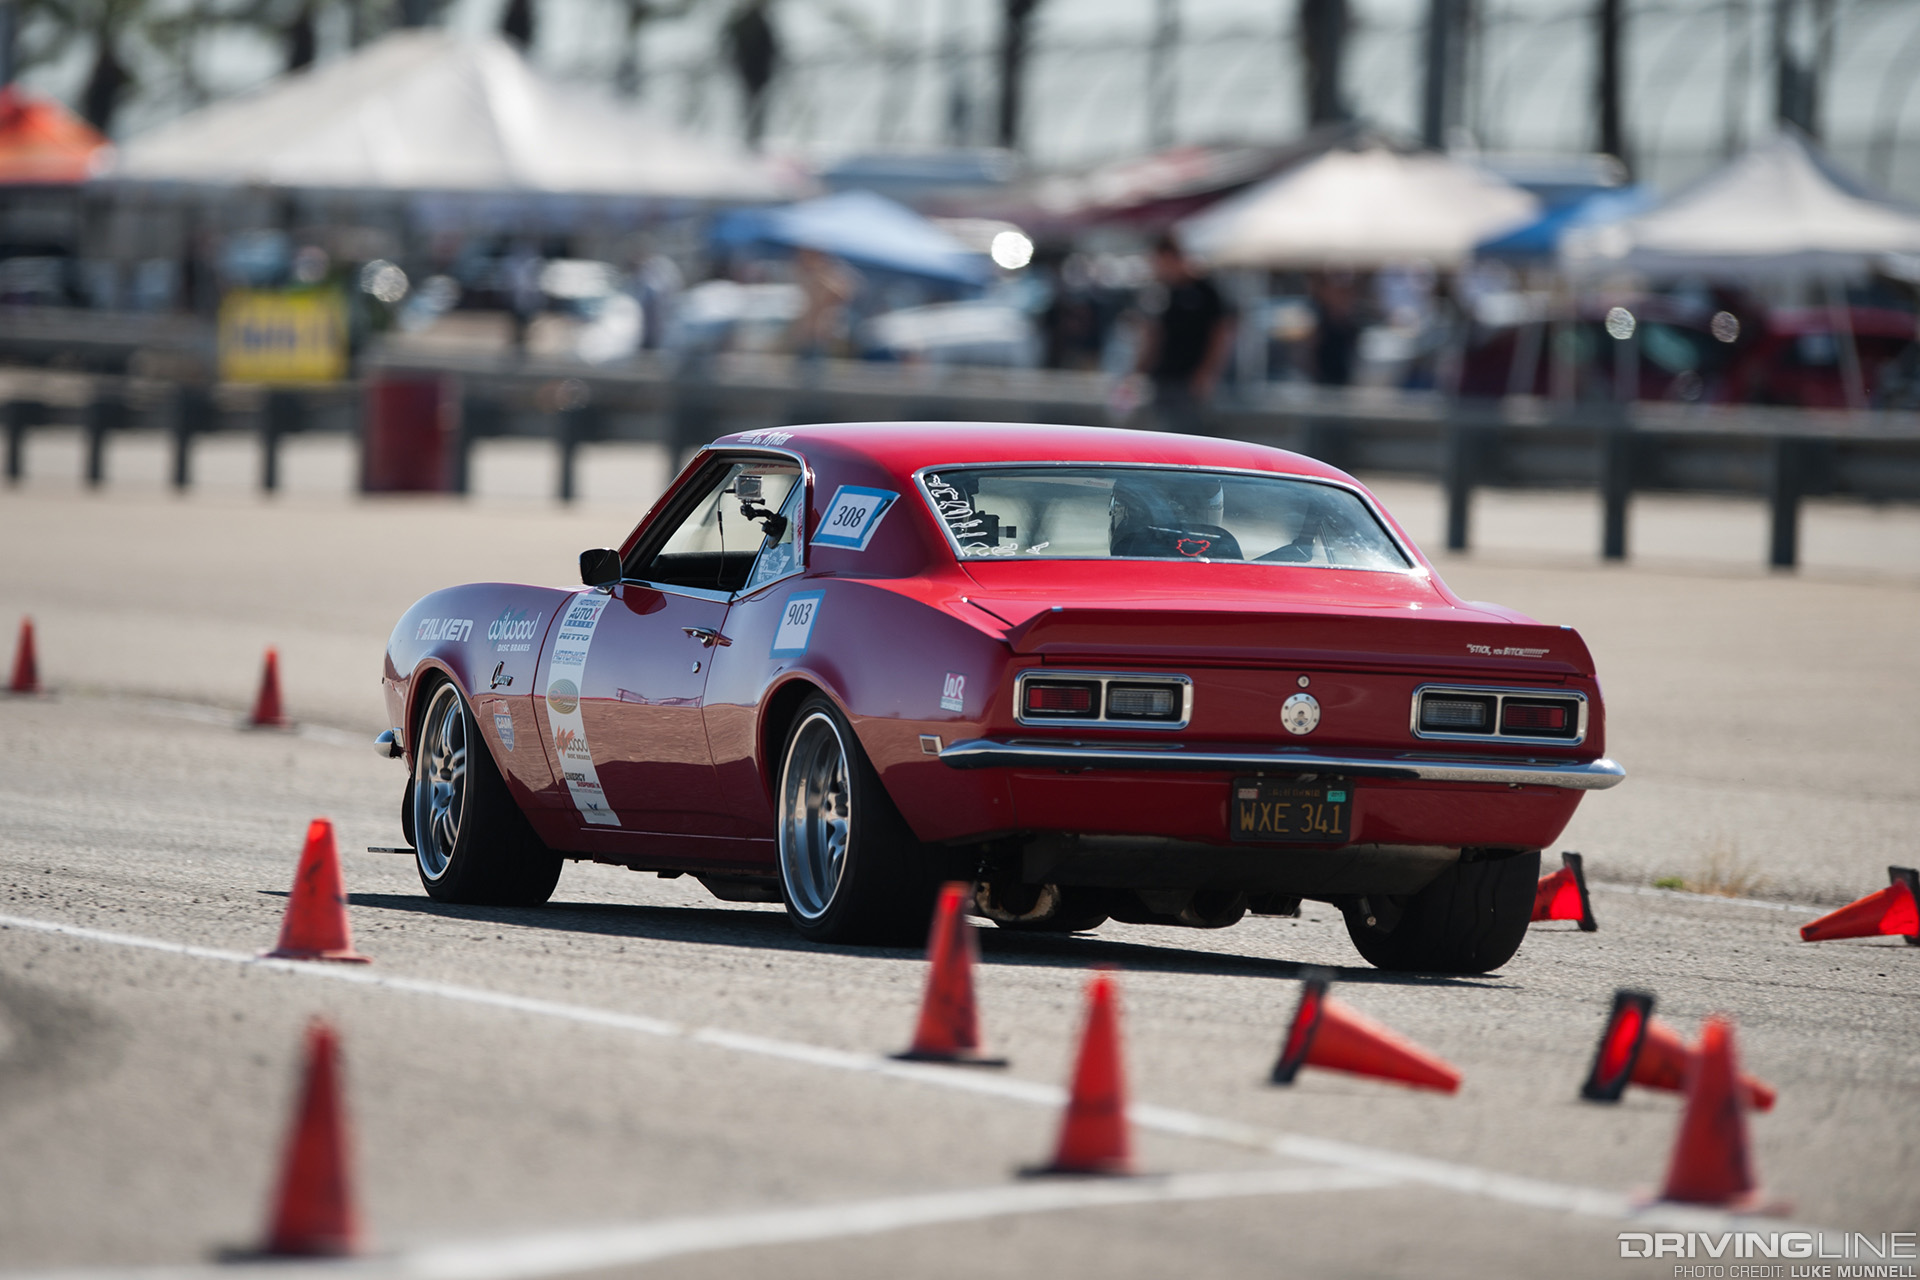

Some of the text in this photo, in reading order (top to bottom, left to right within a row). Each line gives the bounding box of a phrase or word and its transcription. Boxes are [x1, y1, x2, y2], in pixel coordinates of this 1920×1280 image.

[832, 505, 866, 528] 308
[786, 603, 812, 625] 903
[415, 618, 474, 642] FALKEN
[496, 717, 512, 729] CAM
[1240, 802, 1342, 834] WXE 341
